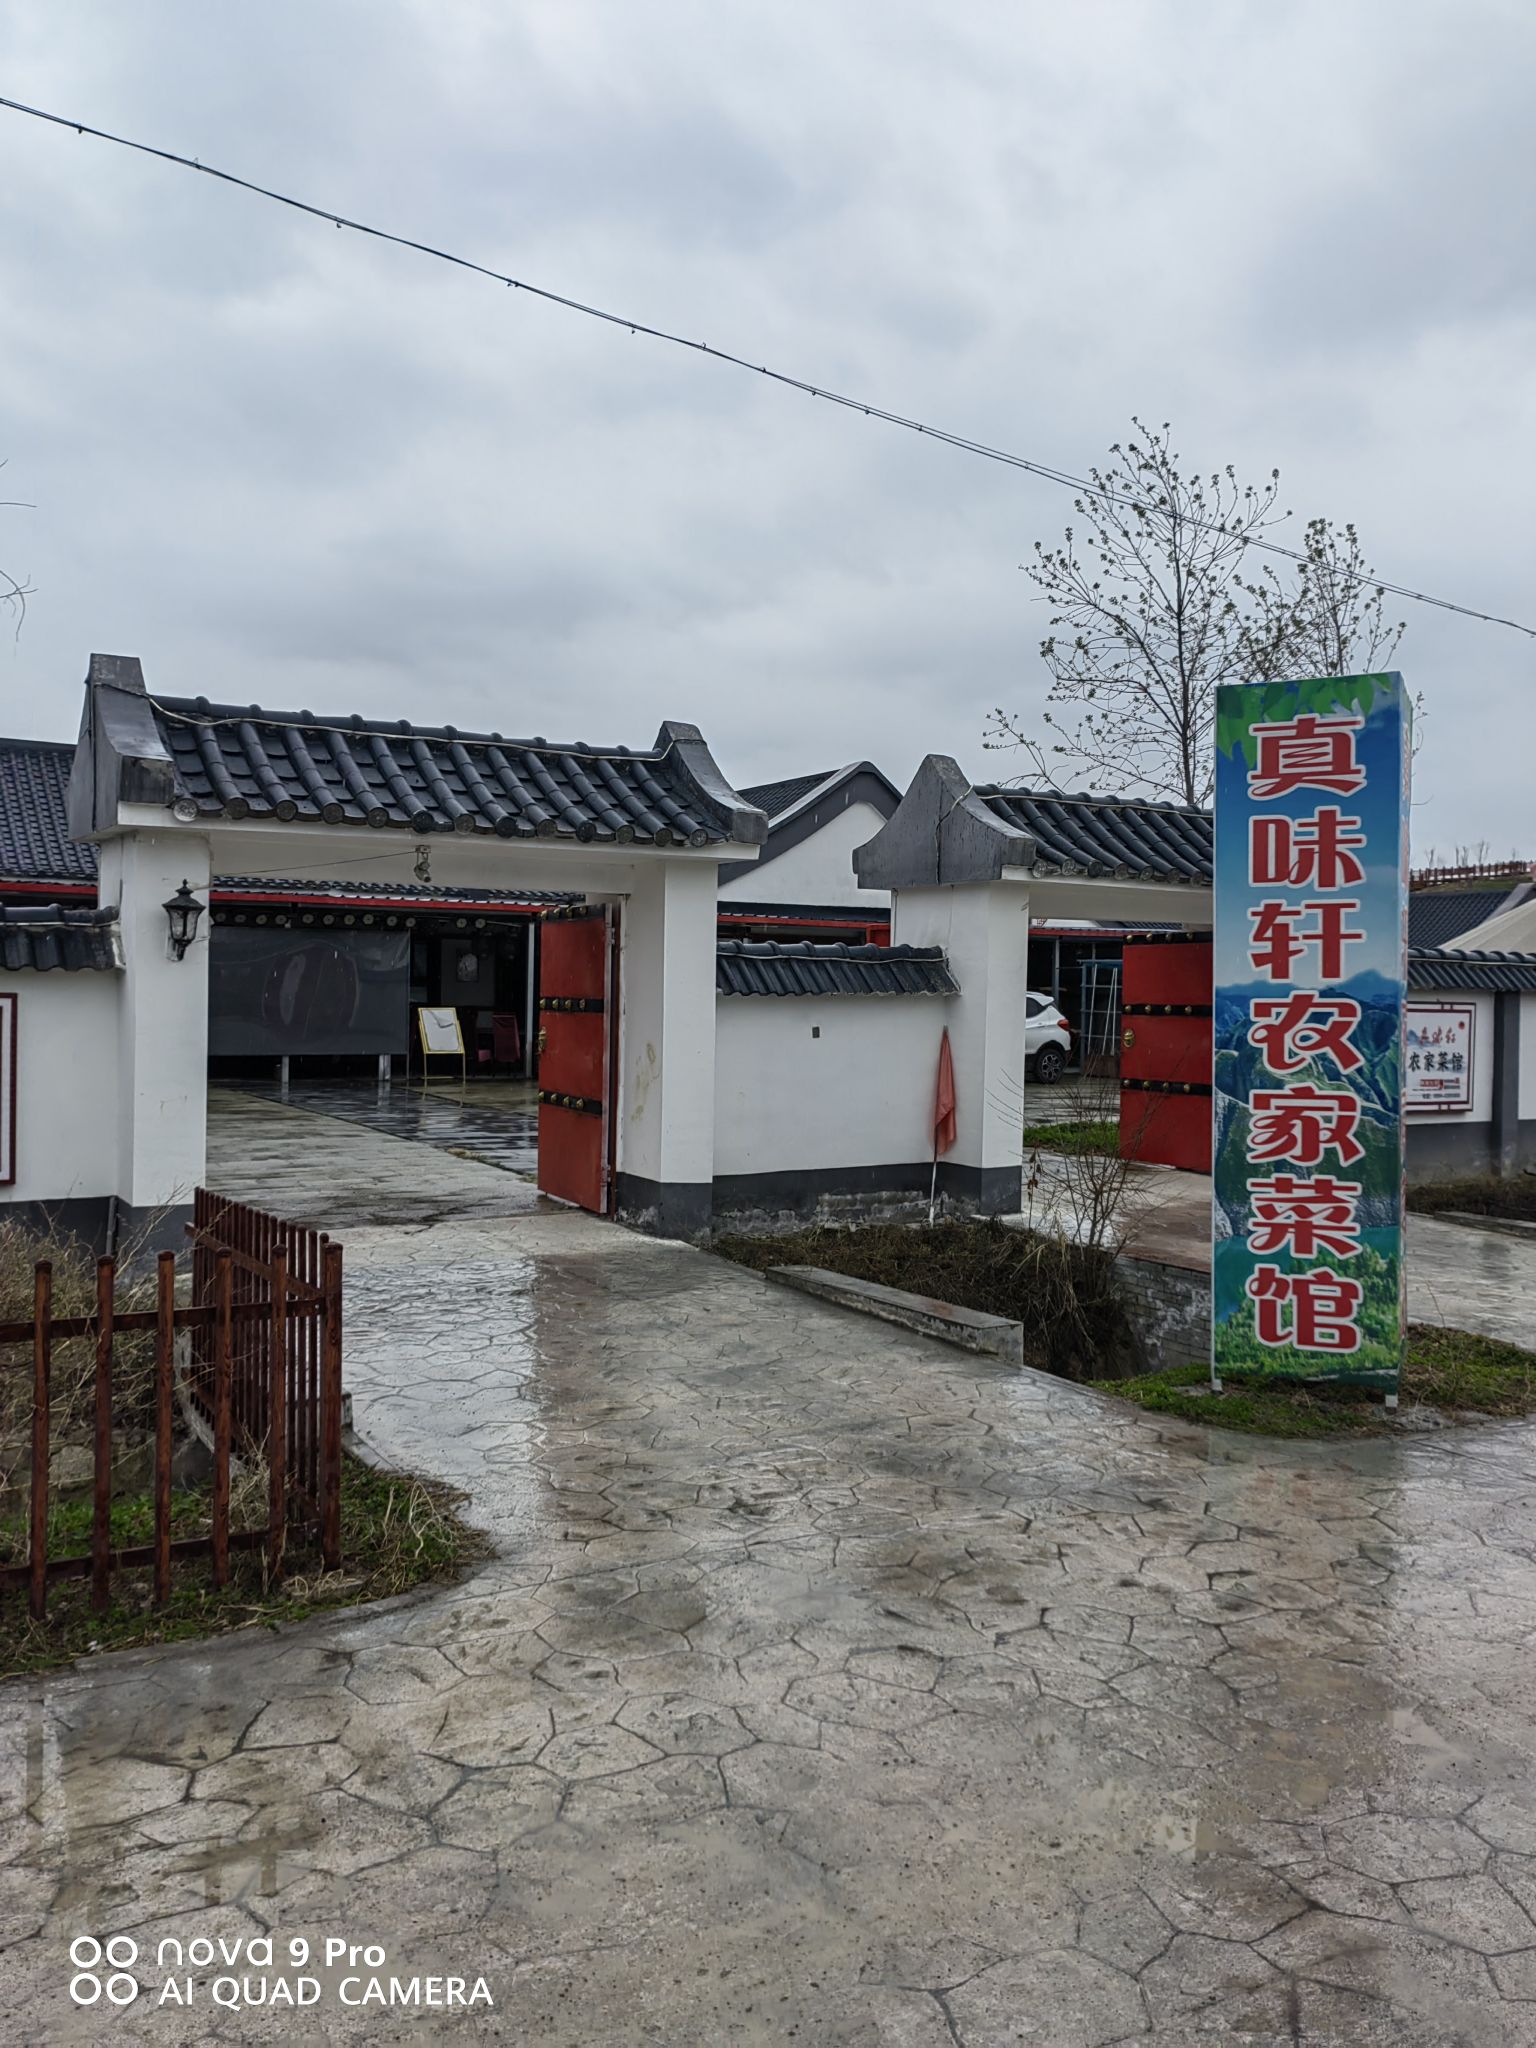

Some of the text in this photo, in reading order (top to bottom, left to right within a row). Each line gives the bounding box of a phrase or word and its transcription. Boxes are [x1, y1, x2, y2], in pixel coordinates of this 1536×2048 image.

[1247, 713, 1365, 1354] 真味轩农家菜馆
[1408, 1051, 1464, 1072] 农家菜馆
